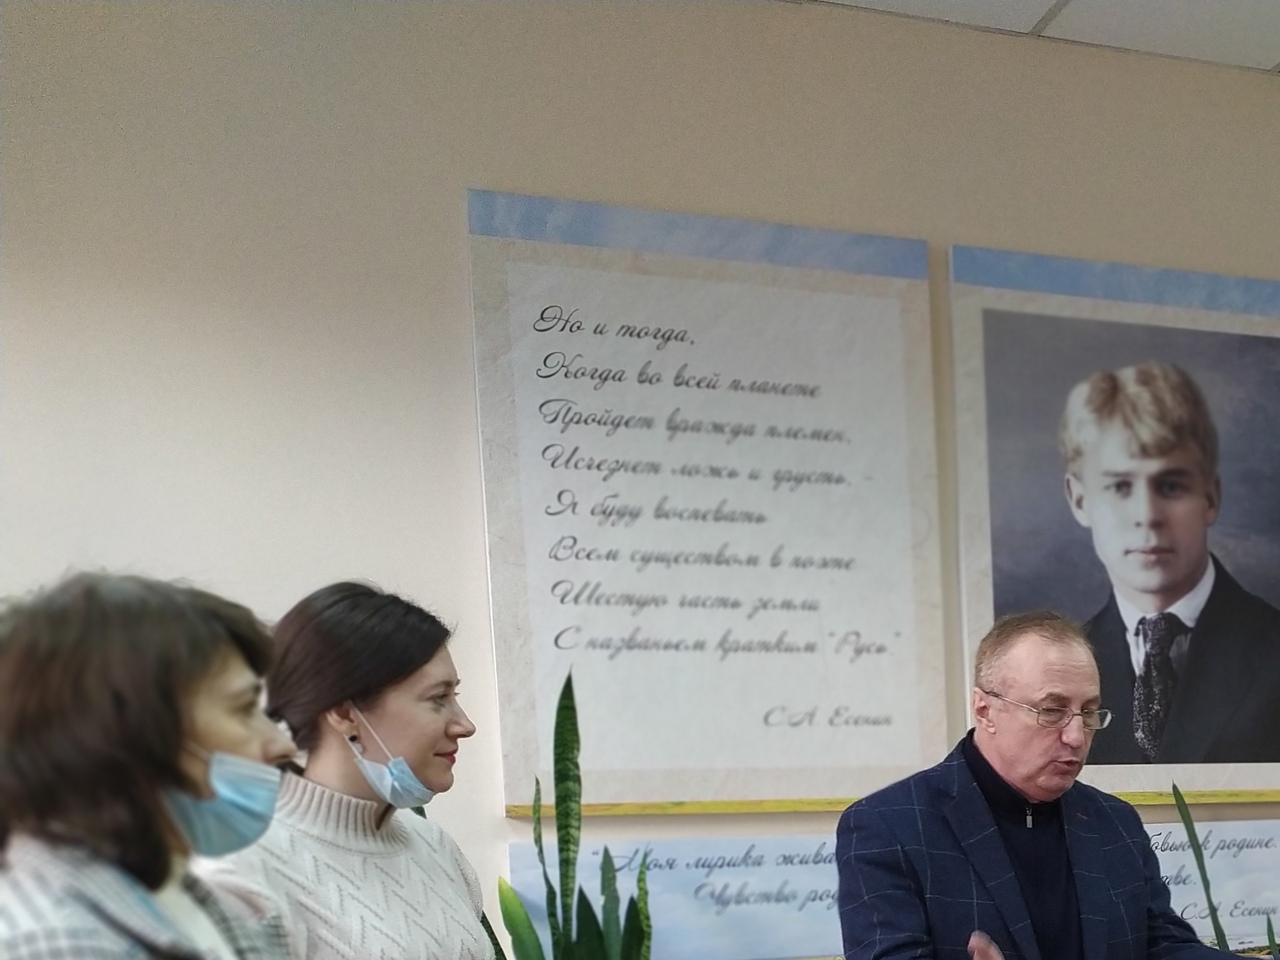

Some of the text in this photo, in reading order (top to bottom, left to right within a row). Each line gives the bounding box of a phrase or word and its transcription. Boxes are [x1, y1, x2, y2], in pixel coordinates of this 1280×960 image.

[532, 305, 584, 334] Но
[593, 321, 609, 336] и
[535, 351, 823, 399] Когда во всей планете
[538, 398, 656, 437] Пройдет
[666, 407, 757, 446] вражда
[541, 443, 662, 483] Исчезнет
[671, 462, 740, 480] ложь
[747, 467, 762, 481] и
[544, 488, 768, 531] Я буду воспевать
[548, 535, 857, 573] Всем существом в поэте
[550, 579, 822, 620] Шестую часть земли
[554, 625, 582, 651] С
[584, 628, 707, 661] названьем
[715, 628, 819, 663] кратким
[828, 705, 894, 728] Есенин
[685, 843, 767, 879] лирика
[693, 878, 798, 916] Чувство
[1230, 901, 1279, 918] Есенин
